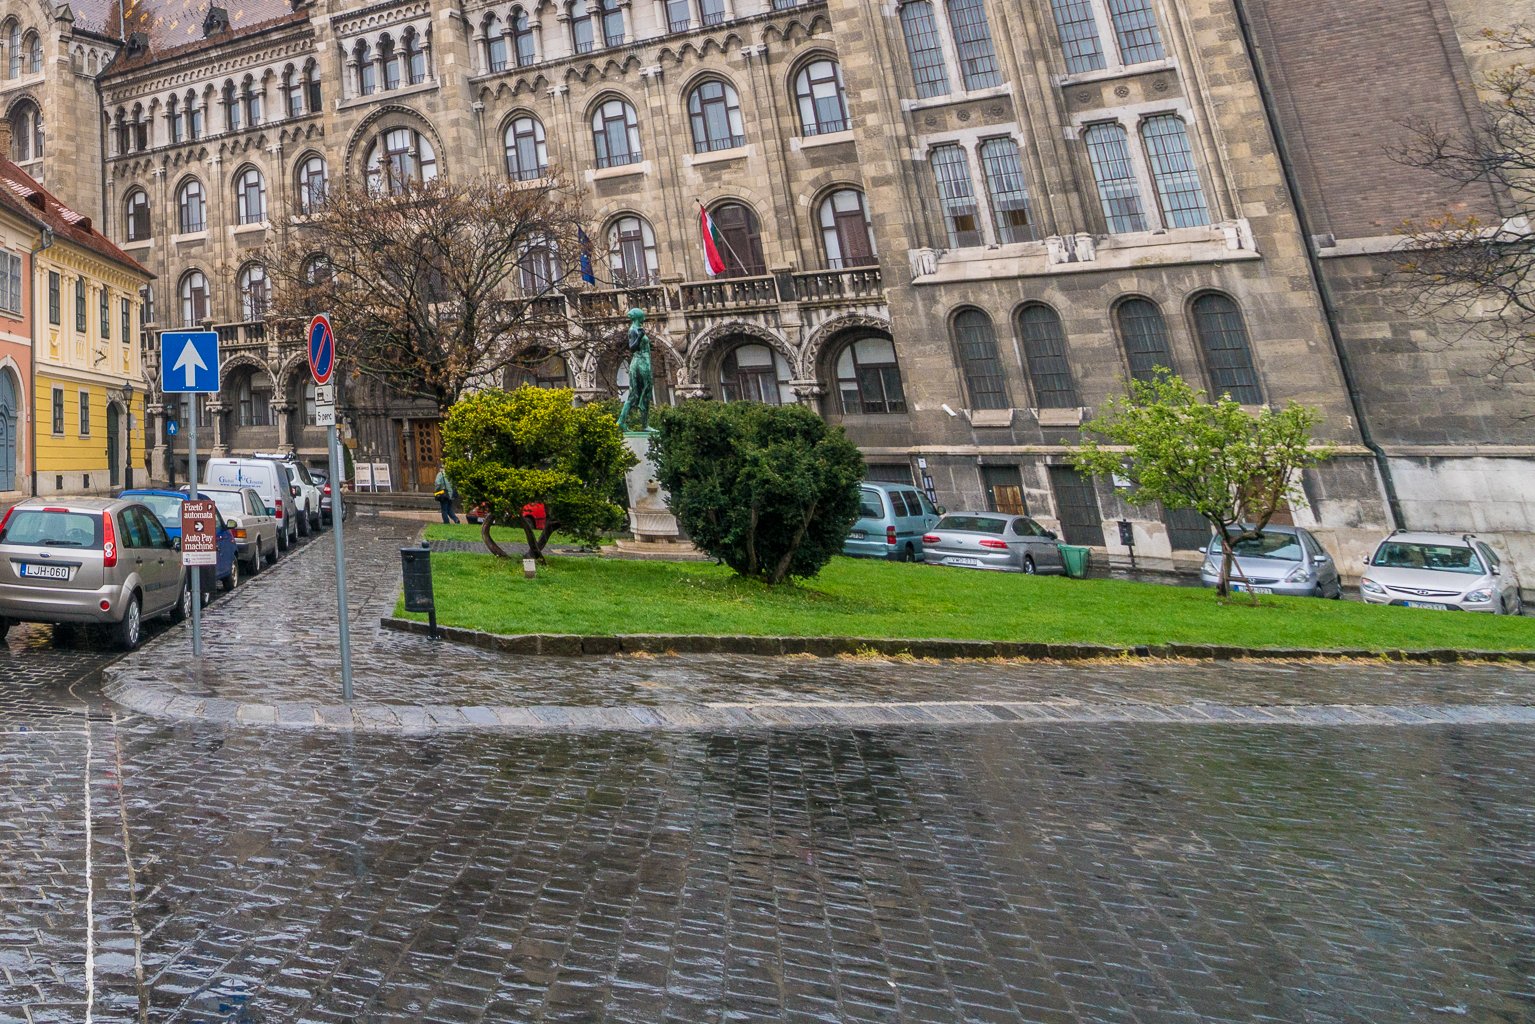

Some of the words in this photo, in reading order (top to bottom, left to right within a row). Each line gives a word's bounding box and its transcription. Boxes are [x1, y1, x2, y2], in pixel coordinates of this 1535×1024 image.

[317, 411, 322, 421] 5
[322, 413, 332, 422] perc
[184, 503, 203, 511] Fizető
[185, 534, 201, 543] Auto
[201, 534, 214, 543] Pay
[185, 541, 214, 550] machine
[27, 566, 67, 578] LJH-060
